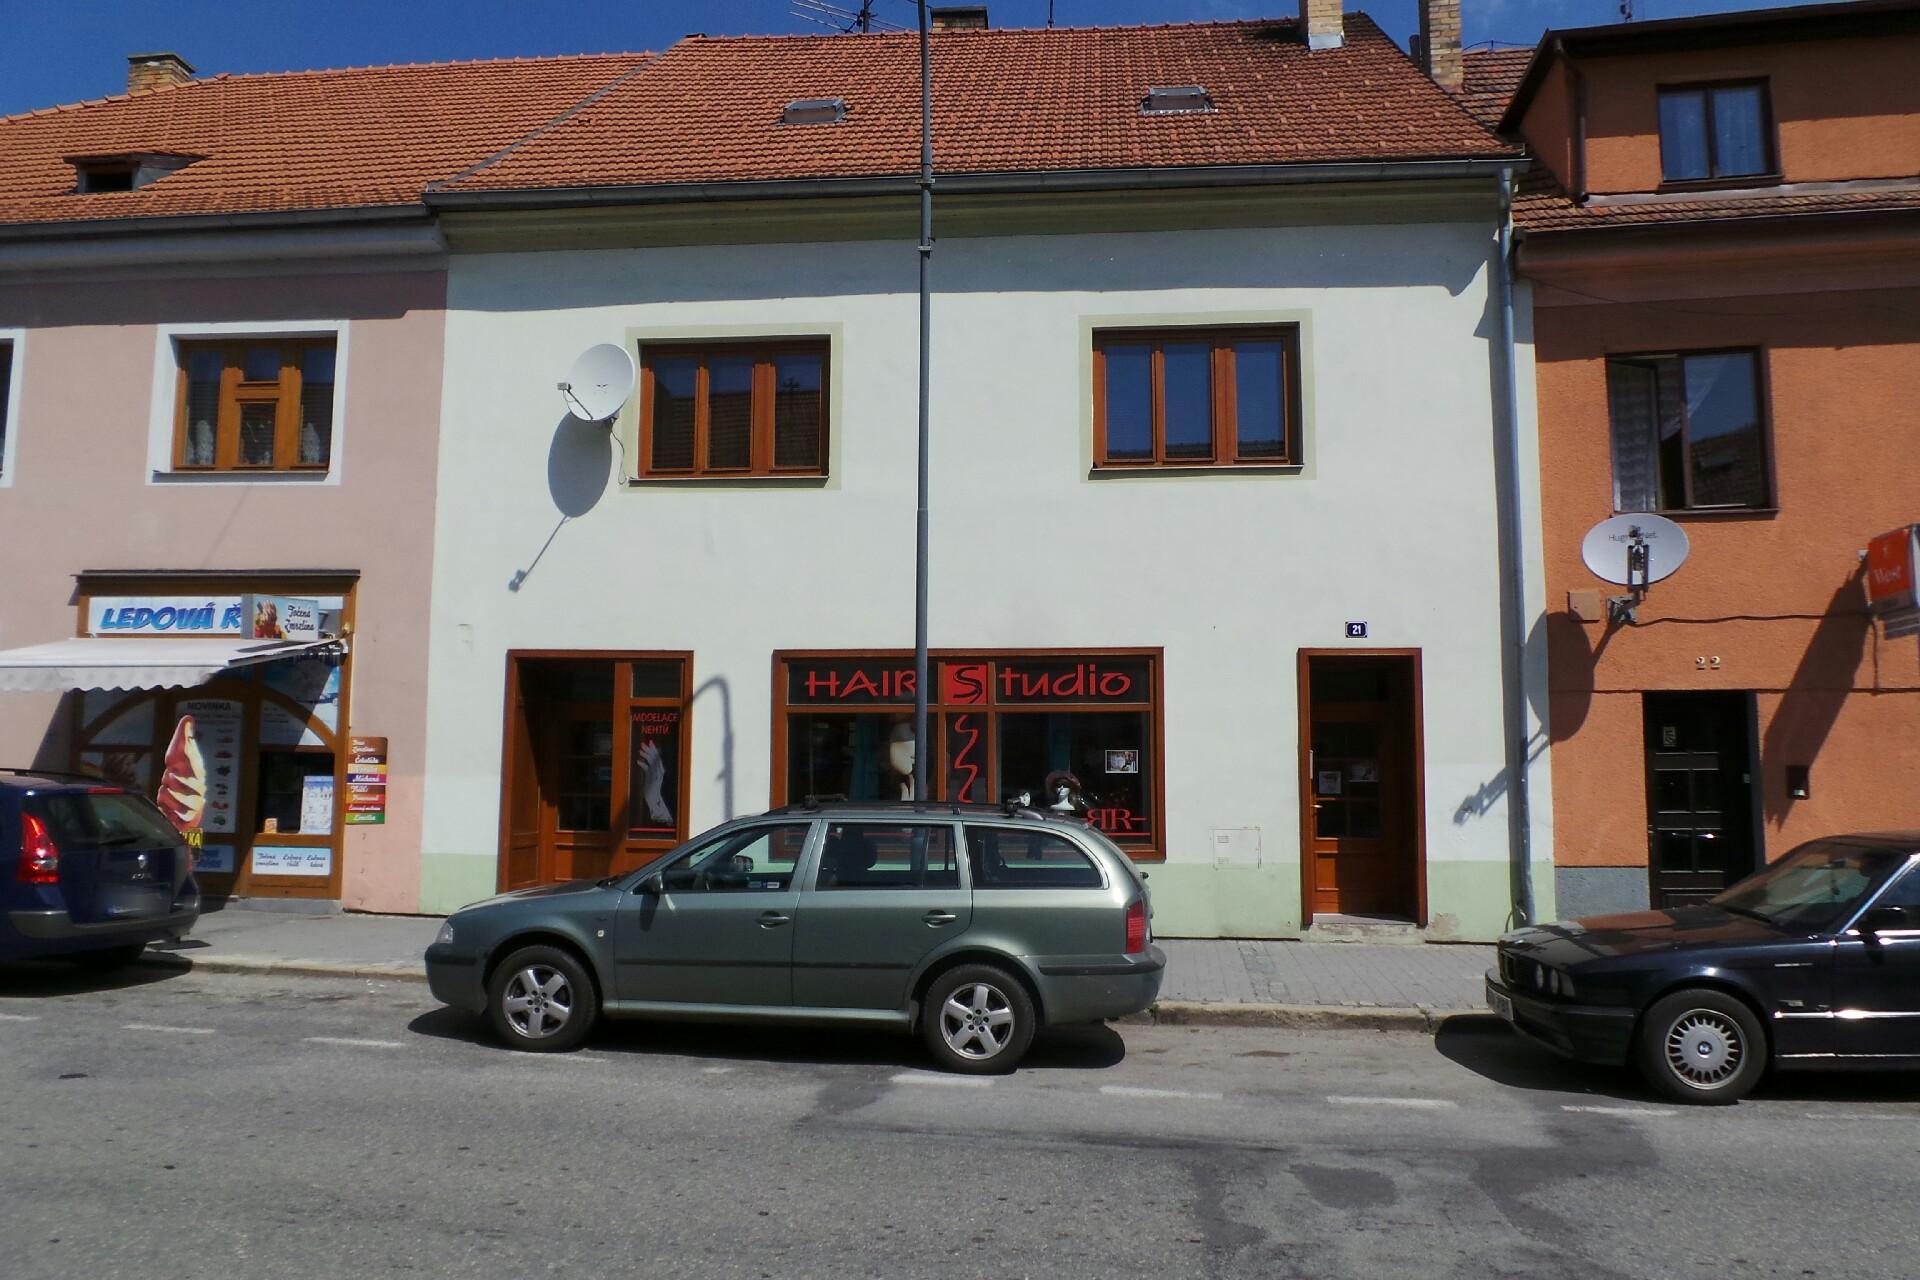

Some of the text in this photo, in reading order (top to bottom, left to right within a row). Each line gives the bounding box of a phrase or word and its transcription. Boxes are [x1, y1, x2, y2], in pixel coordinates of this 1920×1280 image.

[100, 601, 216, 630] LEDOVÁ
[1352, 624, 1362, 635] 21
[804, 669, 916, 698] HAIR
[632, 712, 679, 722] MODELACE
